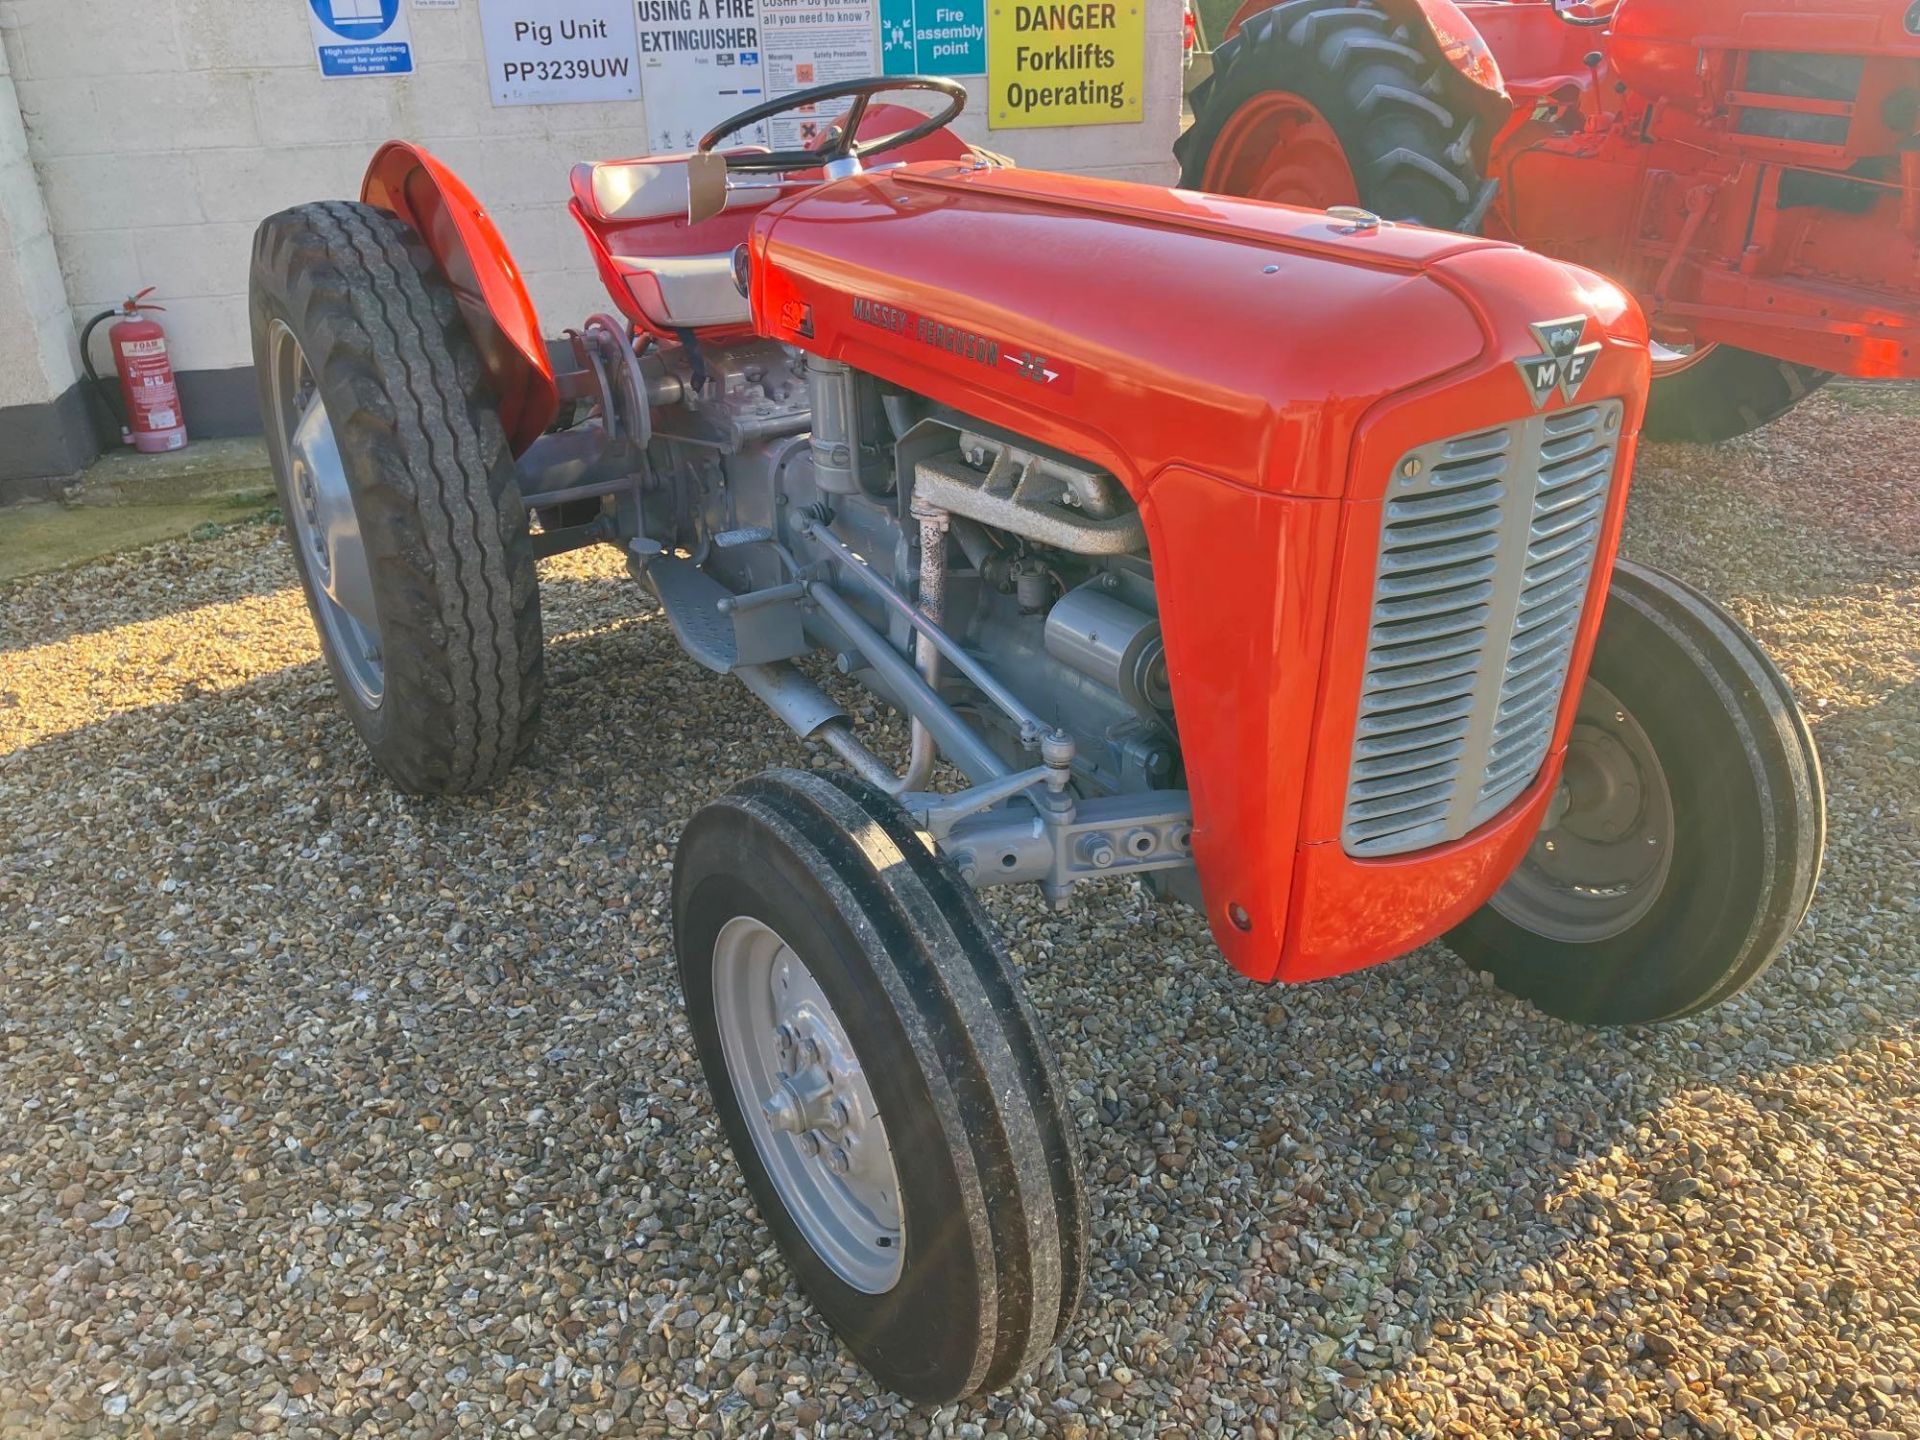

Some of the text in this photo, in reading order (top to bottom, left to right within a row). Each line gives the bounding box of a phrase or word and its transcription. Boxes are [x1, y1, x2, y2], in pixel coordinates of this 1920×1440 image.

[638, 0, 755, 21] USING A FIRE
[763, 14, 777, 24] all
[779, 15, 796, 26] you
[799, 12, 823, 23] need
[825, 11, 835, 22] to
[837, 11, 862, 22] know
[936, 9, 964, 23] Fire
[1015, 4, 1116, 31] DANGER
[514, 19, 608, 45] Pig Unit
[640, 28, 758, 52] EXTINGUISHER
[916, 25, 984, 42] assembly
[324, 48, 343, 56] High
[933, 41, 969, 59] point
[1016, 43, 1115, 71] Forklifts
[504, 58, 629, 81] PP3239UW
[1007, 80, 1124, 112] Operating
